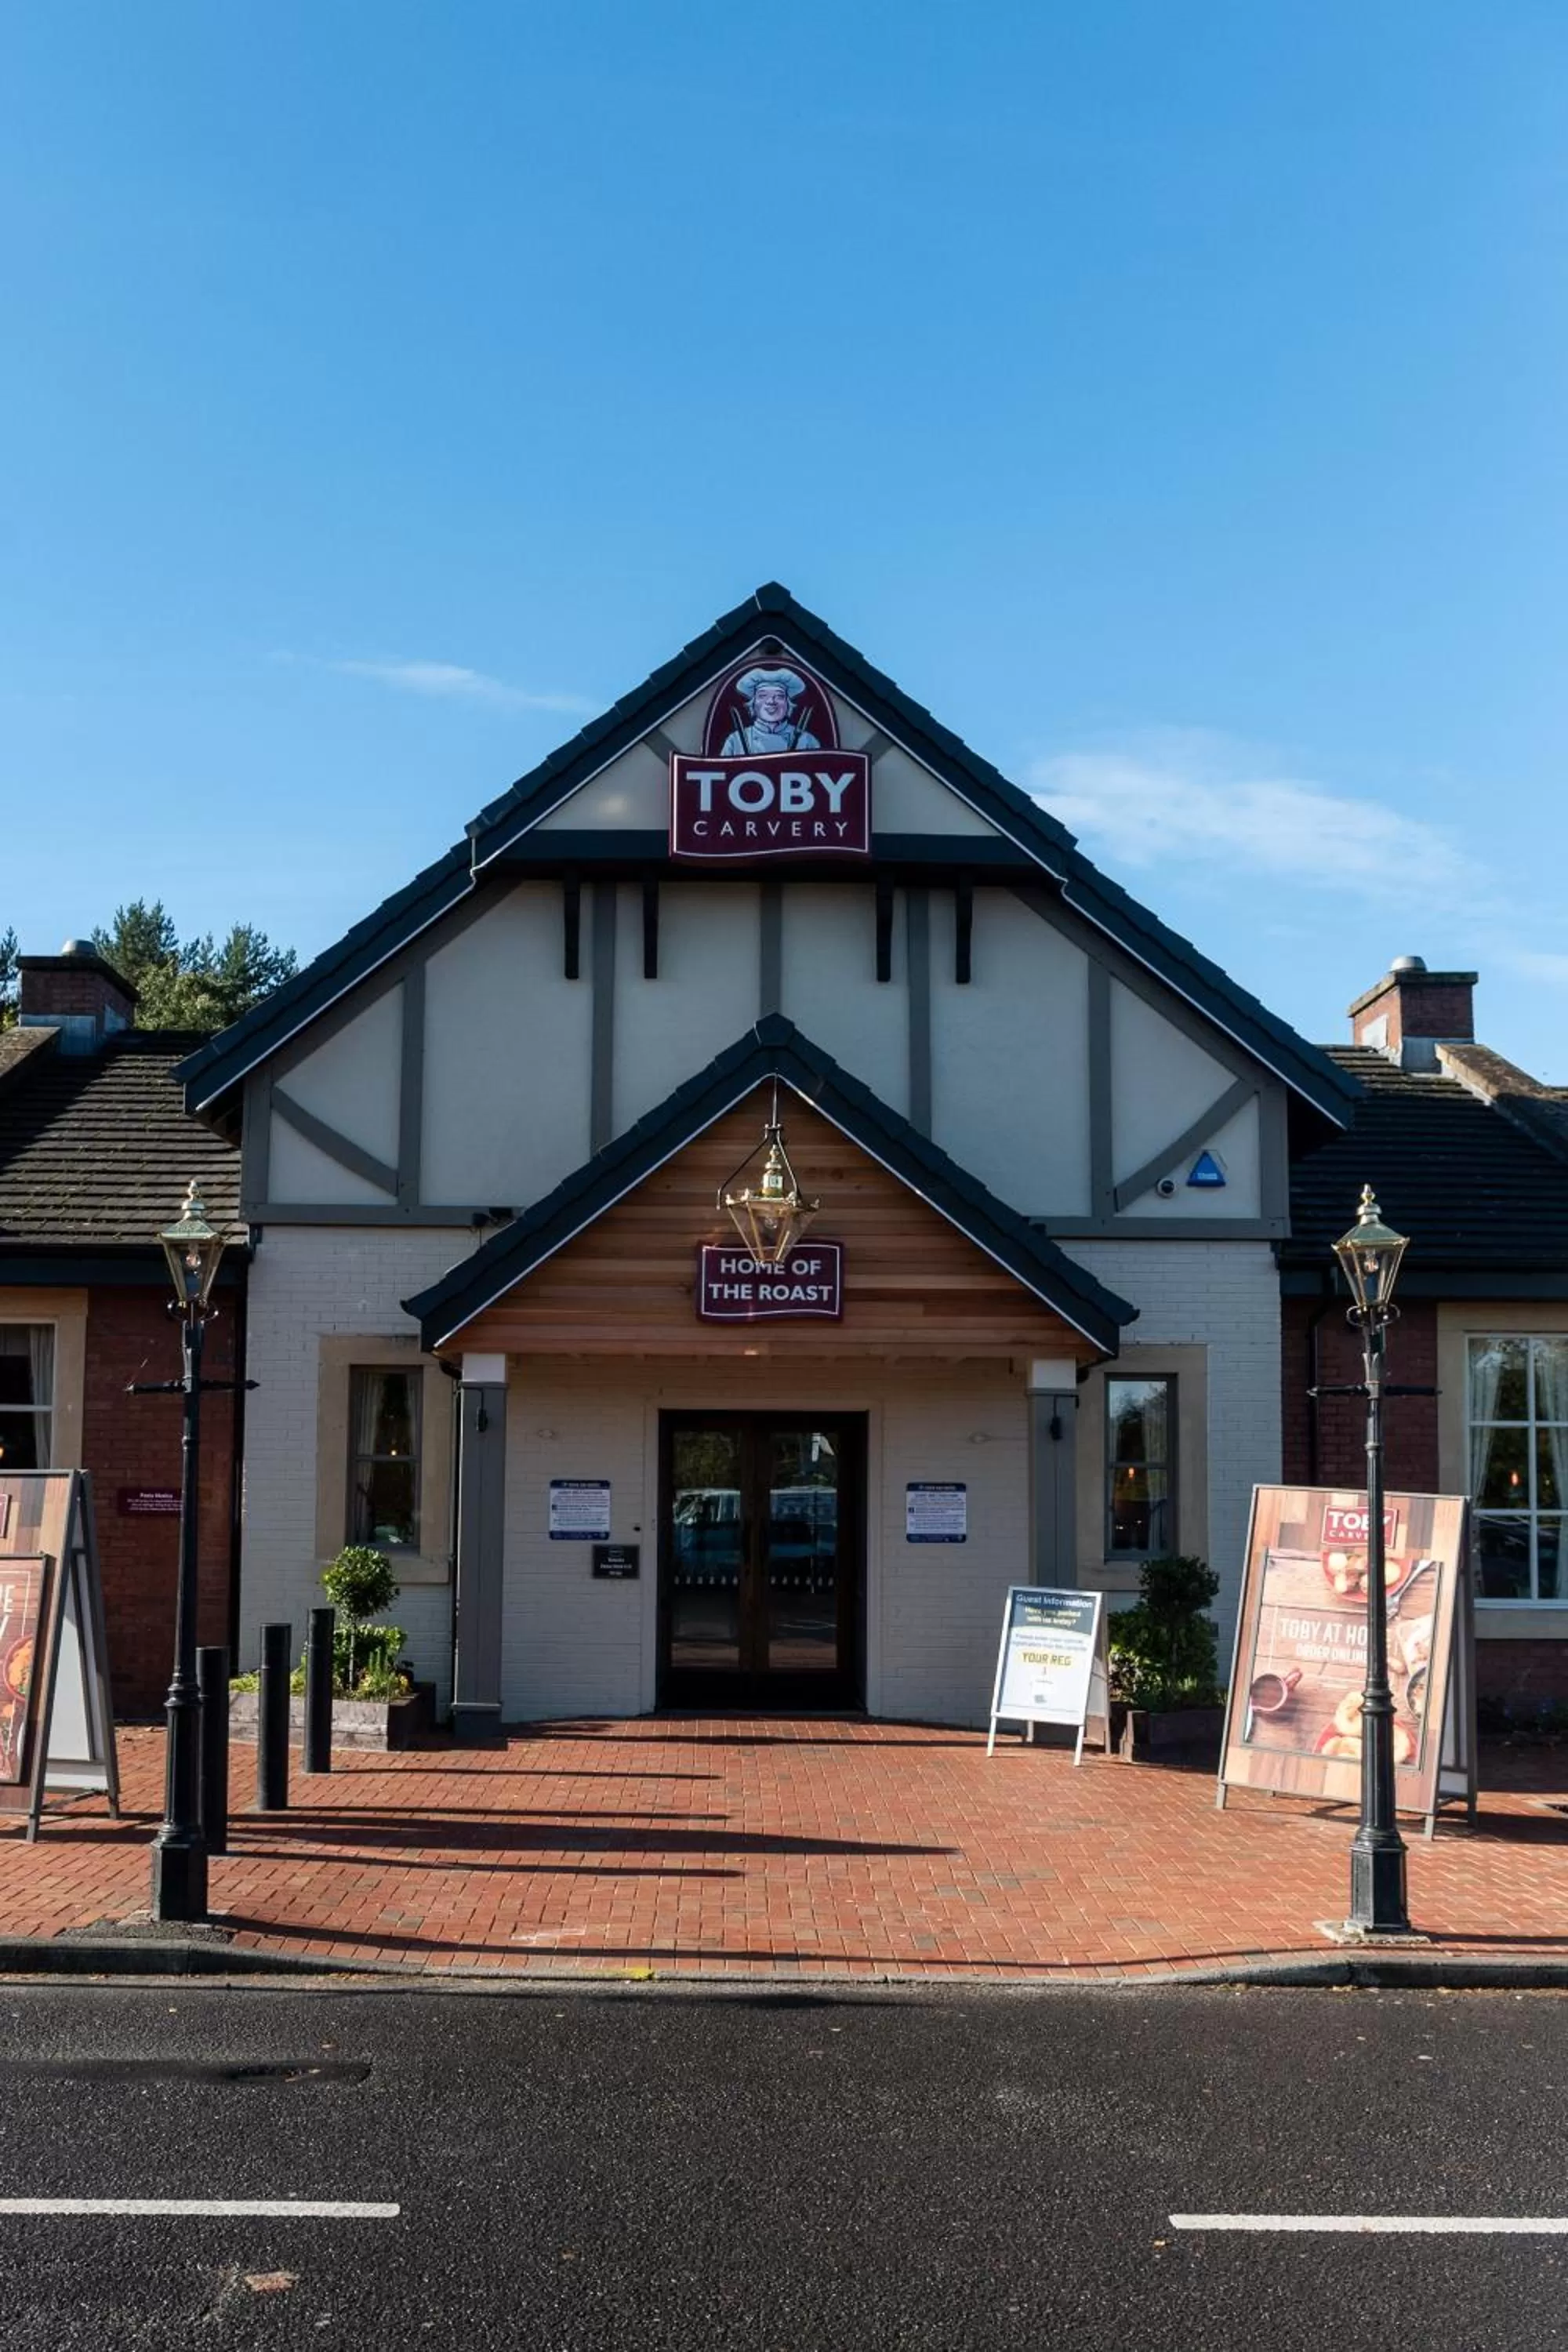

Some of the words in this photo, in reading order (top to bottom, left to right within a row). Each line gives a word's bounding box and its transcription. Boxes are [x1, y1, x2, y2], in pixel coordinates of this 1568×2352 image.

[686, 771, 856, 813] TOBY
[693, 821, 848, 837] CARVERY
[720, 1258, 786, 1275] HOME
[791, 1258, 822, 1275] OF
[709, 1283, 753, 1300] THE
[758, 1284, 833, 1301] ROAST
[1016, 1594, 1042, 1604] Guest
[1044, 1596, 1092, 1608] Information
[1279, 1617, 1321, 1642] TOBY
[1323, 1623, 1343, 1643] AT
[1296, 1643, 1330, 1658] ORDER
[1022, 1652, 1049, 1663] YOUR
[1051, 1655, 1072, 1666] REG
